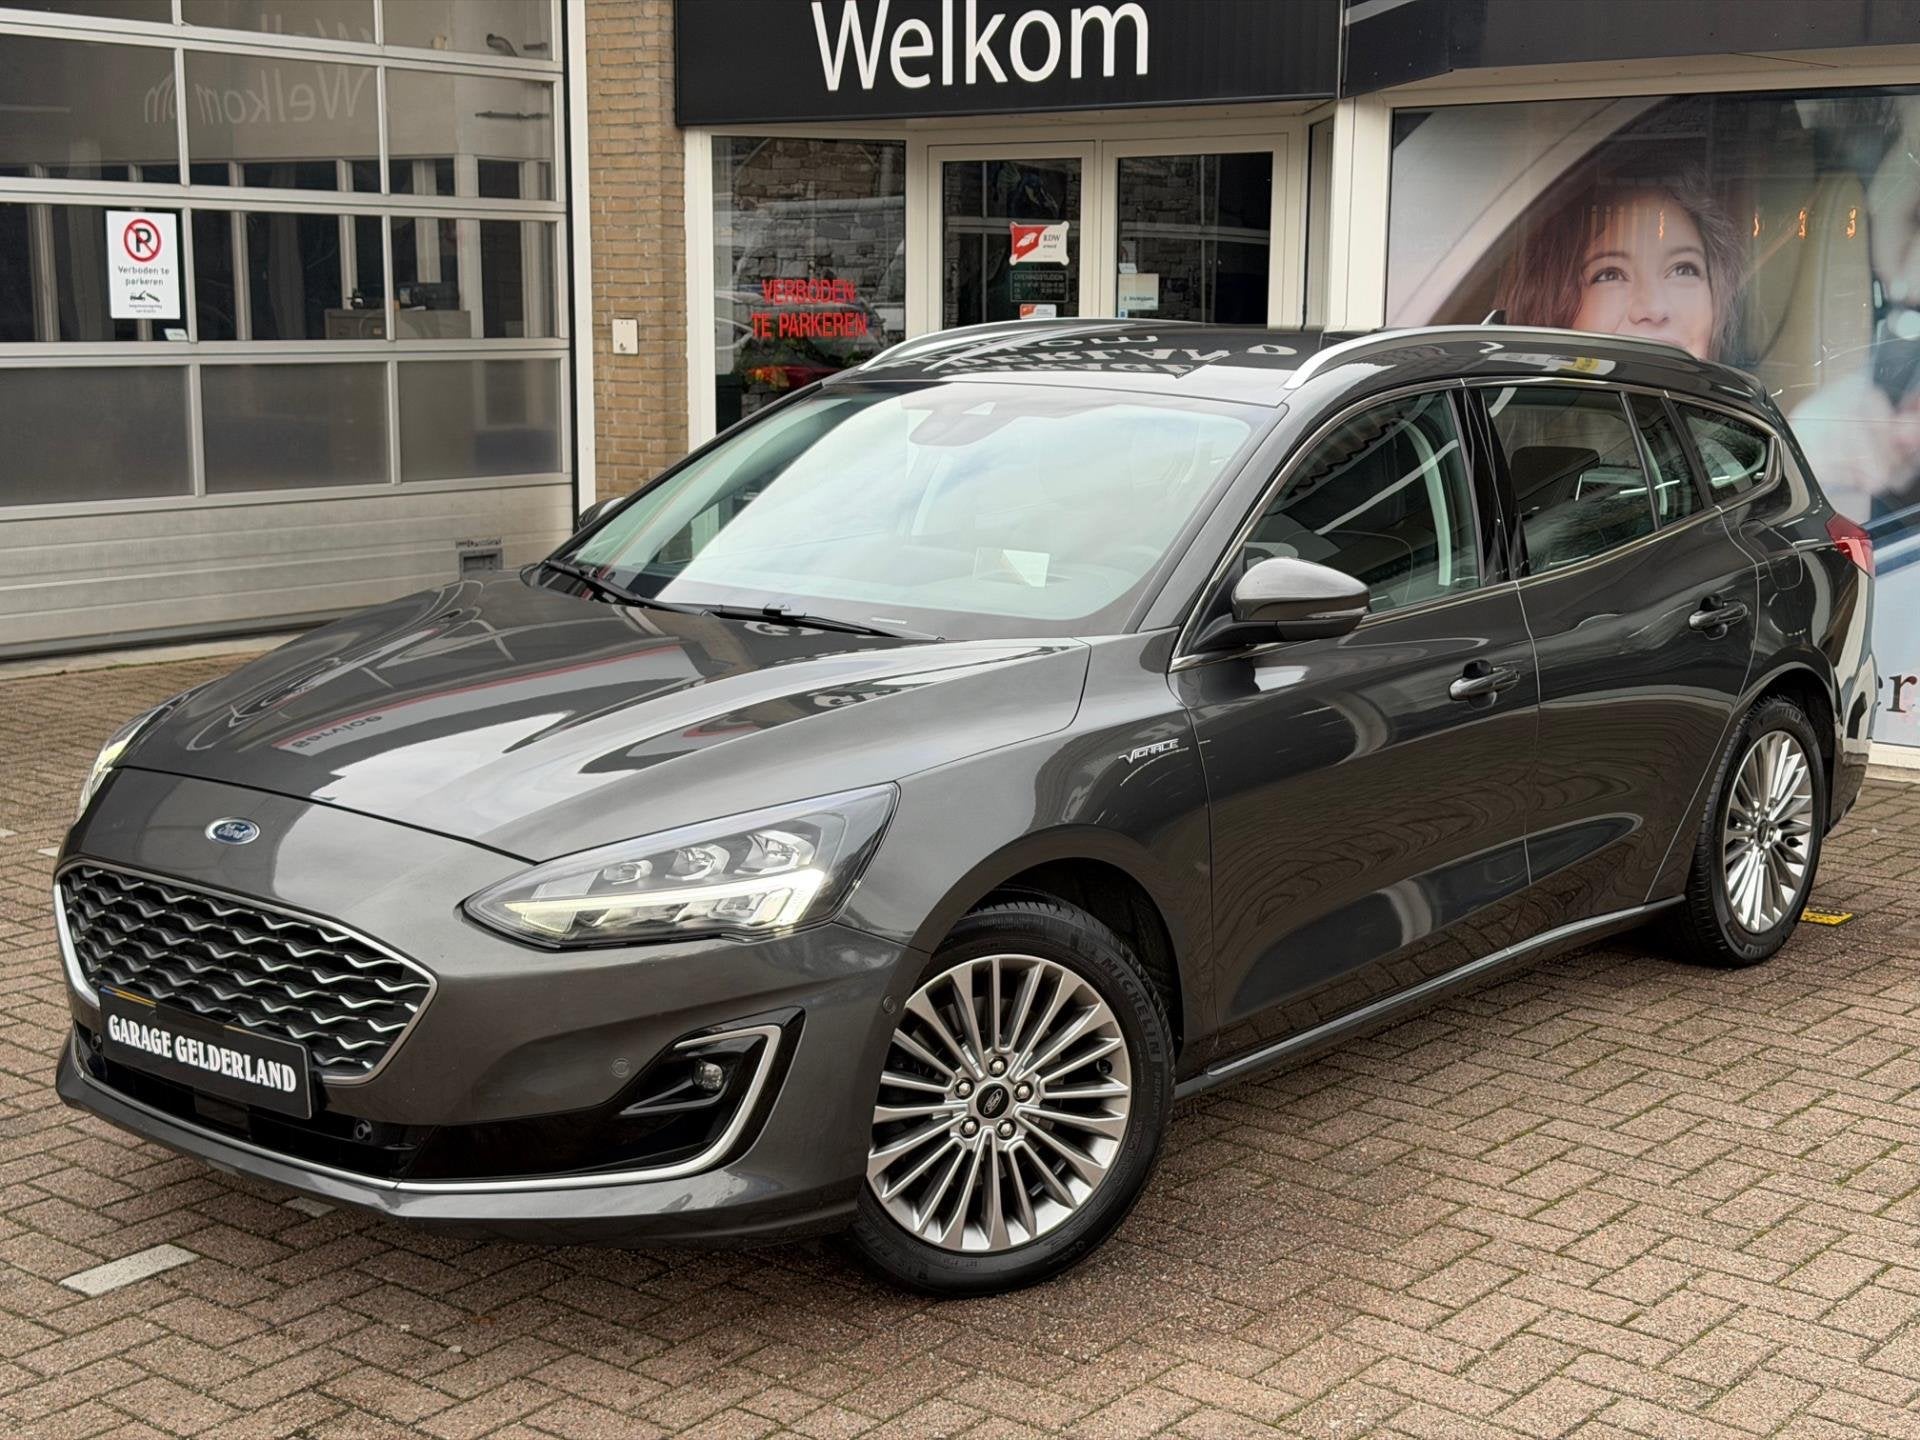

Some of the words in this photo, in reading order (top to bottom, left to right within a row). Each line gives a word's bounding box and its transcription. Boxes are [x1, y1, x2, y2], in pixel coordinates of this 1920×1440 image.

[811, 0, 1149, 92] Welkom
[118, 265, 159, 275] Verboden
[161, 266, 170, 275] te
[125, 278, 164, 286] parkeren
[762, 278, 856, 305] VERBODEN
[752, 312, 772, 337] TE
[779, 312, 868, 337] PARKEREN
[1102, 958, 1162, 1062] MICHELIN
[108, 1013, 173, 1059] GARAGE
[174, 1034, 297, 1093] GELDERLAND
